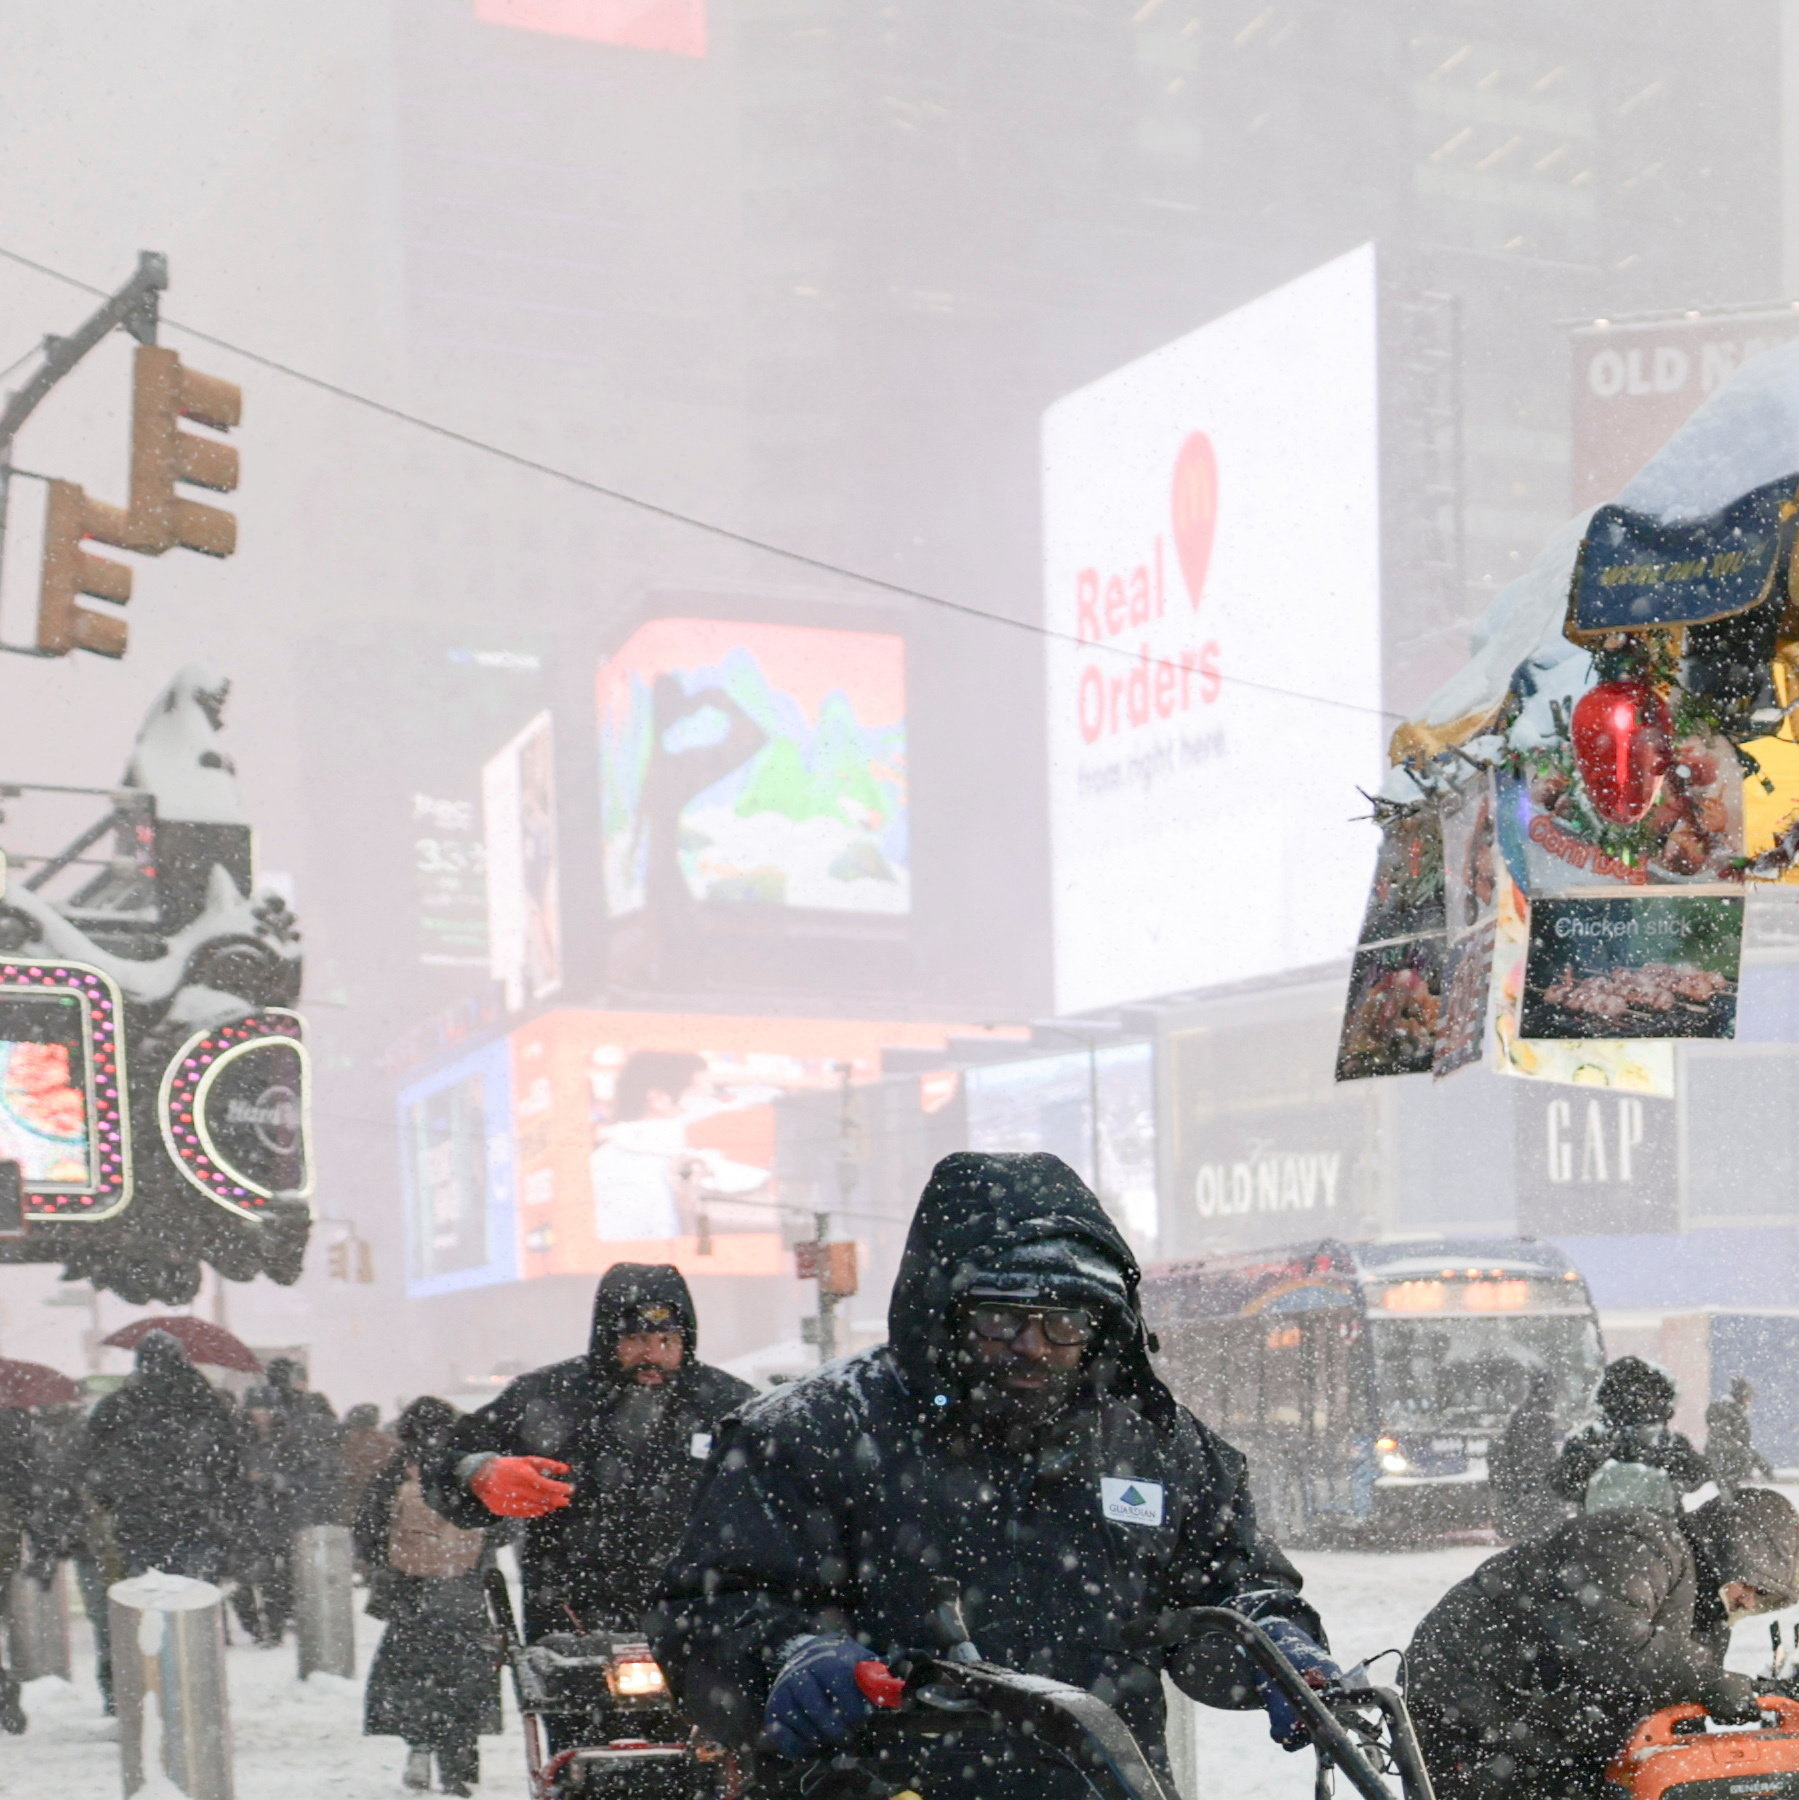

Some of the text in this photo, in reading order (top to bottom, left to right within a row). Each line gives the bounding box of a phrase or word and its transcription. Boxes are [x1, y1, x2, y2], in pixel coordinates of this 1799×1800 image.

[1587, 347, 1691, 397] OLD
[1075, 531, 1165, 648] Real
[1076, 640, 1223, 745] Orders
[1554, 914, 1692, 938] Chicken stick
[1546, 1097, 1645, 1184] GAP
[1196, 1151, 1342, 1218] OLD NAVY
[1109, 1503, 1156, 1518] GUARDIAN
[1729, 1781, 1785, 1795] GENERAC
